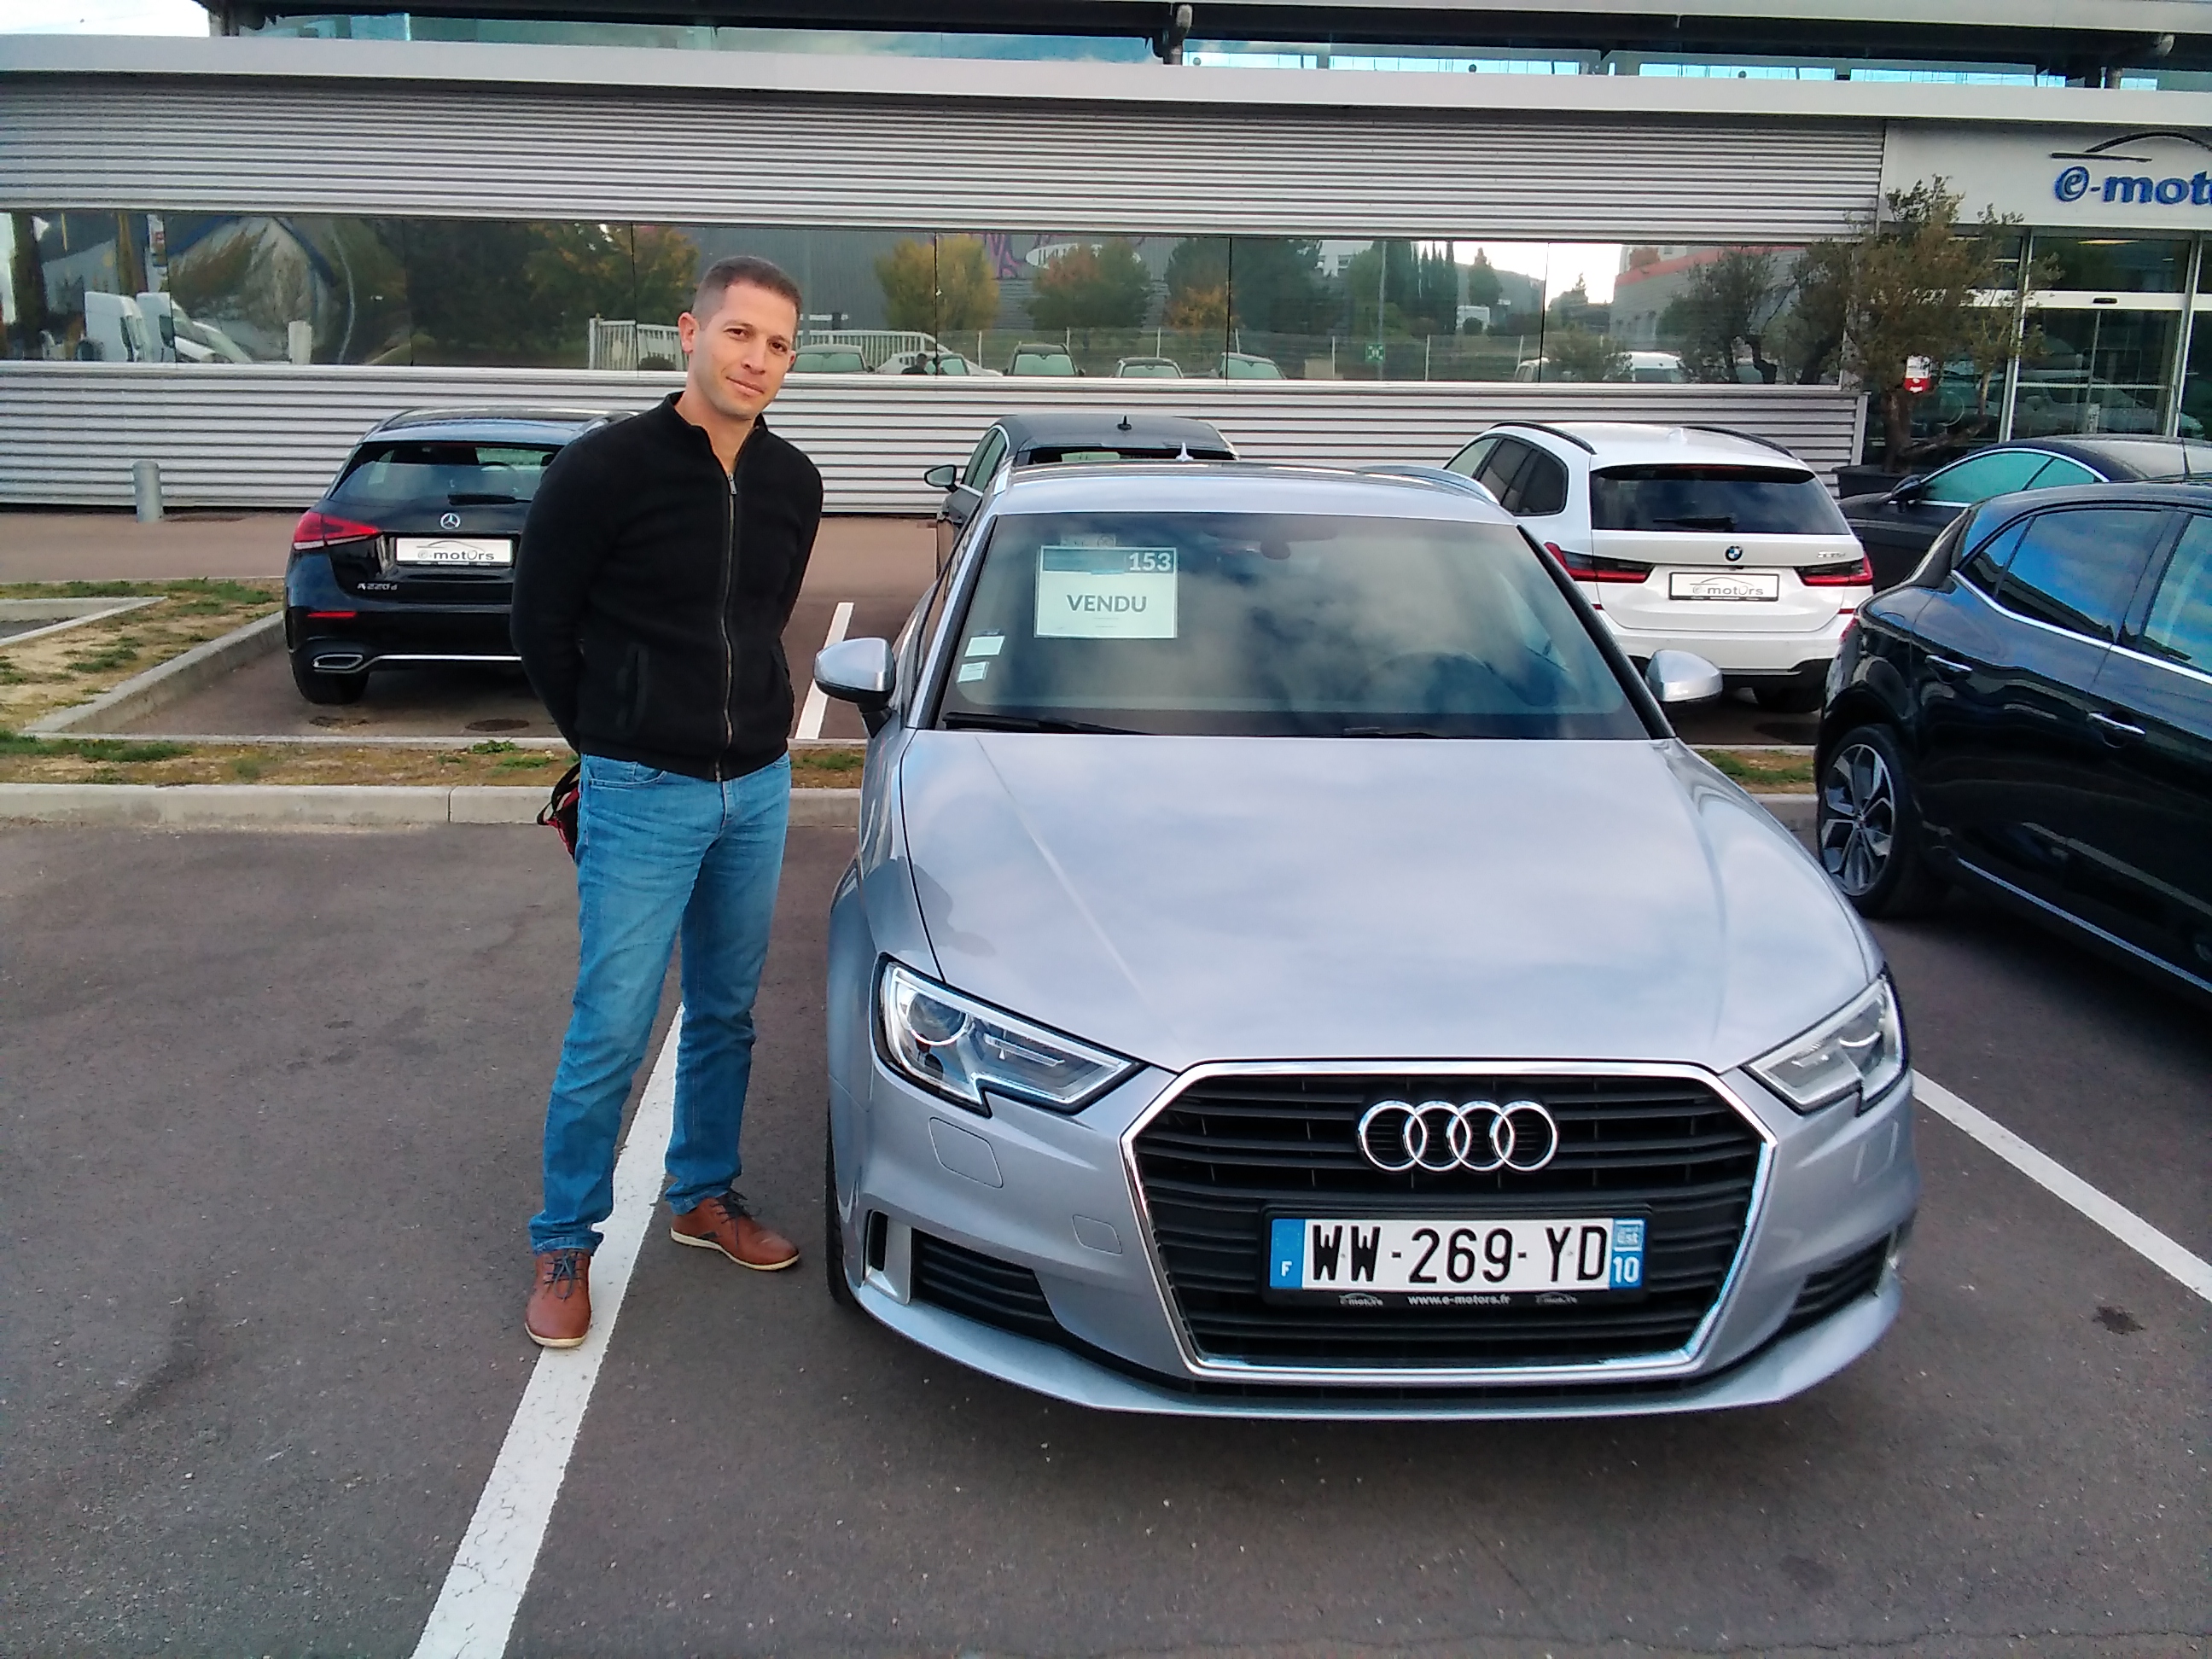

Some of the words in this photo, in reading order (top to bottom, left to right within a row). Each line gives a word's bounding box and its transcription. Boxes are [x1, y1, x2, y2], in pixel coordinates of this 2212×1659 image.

[2054, 166, 2212, 206] e-mot
[1129, 553, 1171, 571] 153
[1066, 594, 1147, 613] VENDU
[1281, 1261, 1291, 1278] F
[1613, 1256, 1639, 1284] 10
